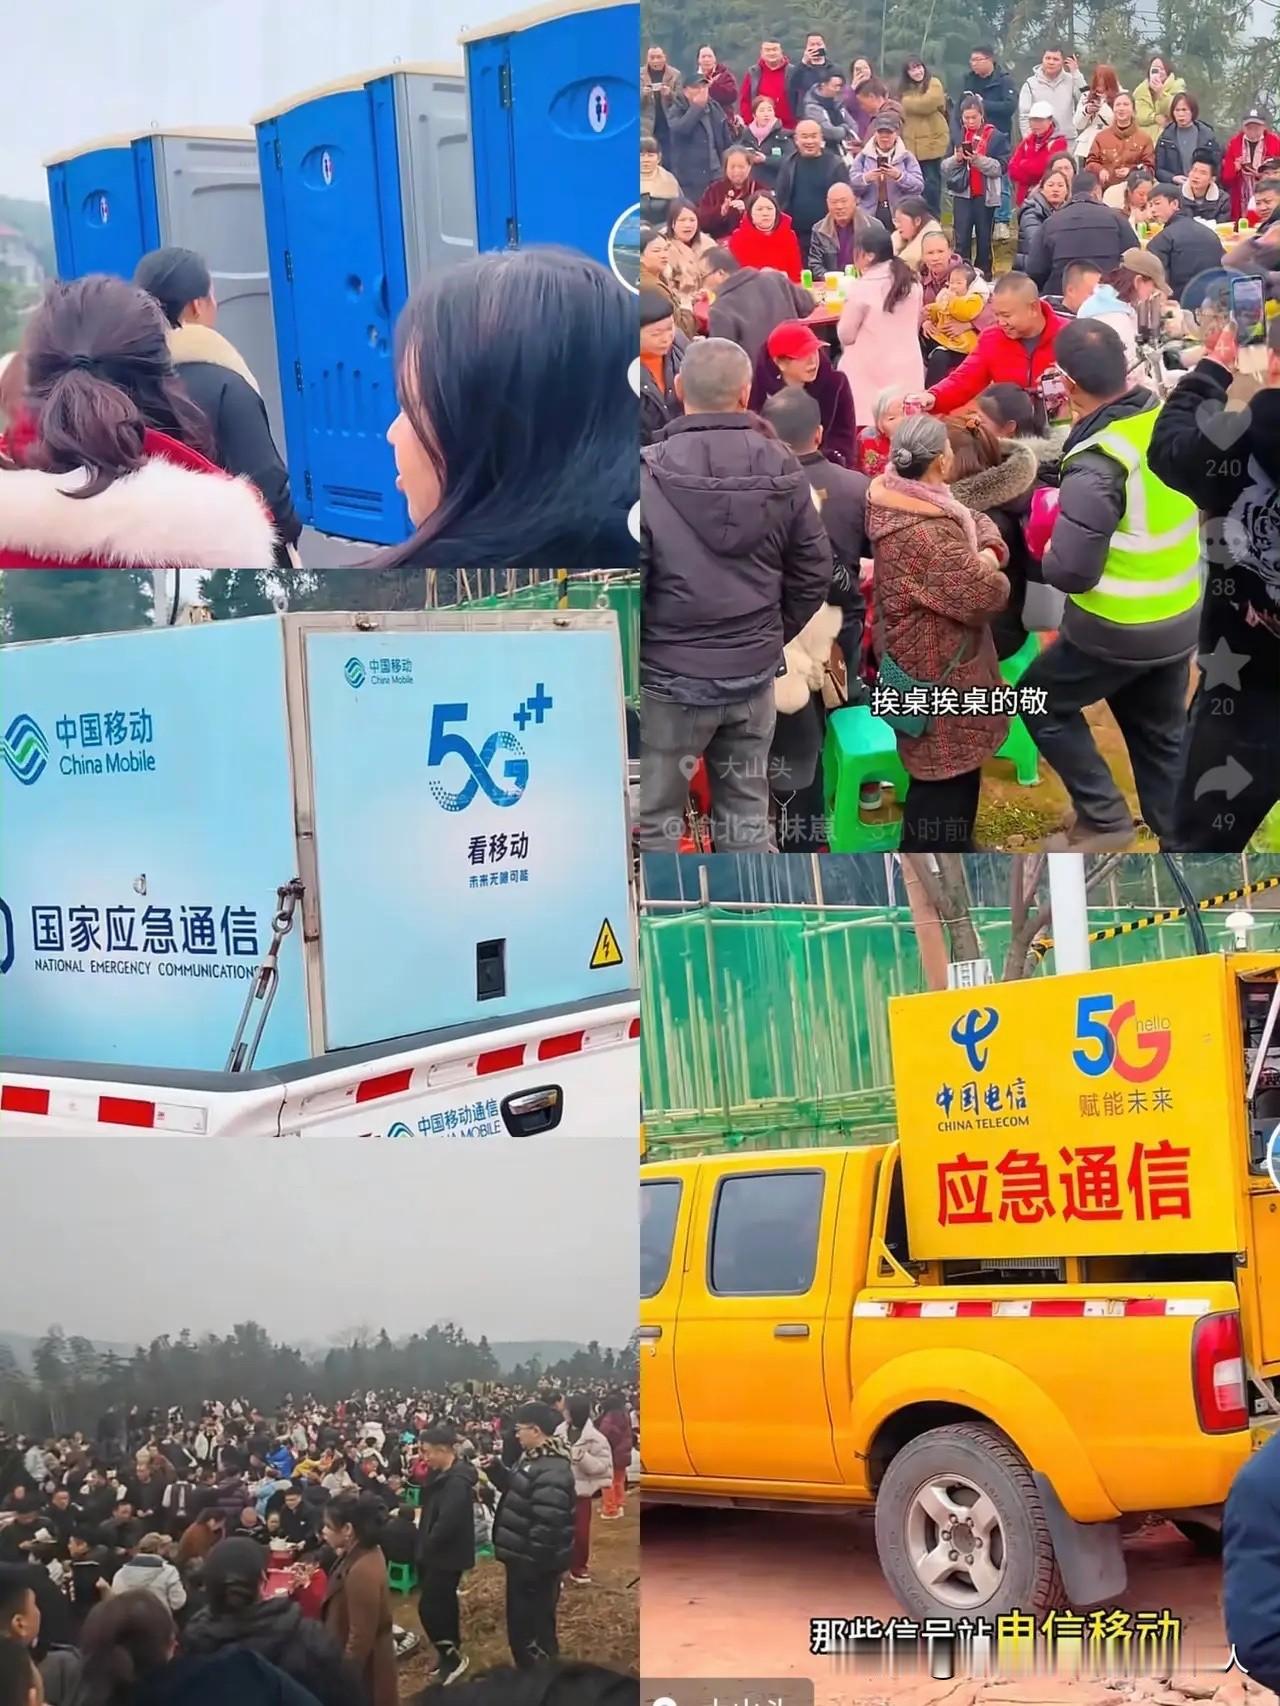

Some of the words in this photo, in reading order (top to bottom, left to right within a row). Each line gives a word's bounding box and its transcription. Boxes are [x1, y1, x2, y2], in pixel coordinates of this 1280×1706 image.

[369, 658, 413, 674] 中国移动
[55, 707, 153, 750] 中国移动
[59, 754, 103, 777] China
[105, 751, 156, 774] Mobile
[467, 830, 529, 866] 看移动
[31, 904, 259, 957] 国家应急通信
[34, 958, 86, 974] NATIONAL
[90, 960, 151, 976] EMERGENCY
[1071, 993, 1172, 1084] 5G
[1135, 1015, 1171, 1033] hello
[935, 1076, 1027, 1120] 中国电信
[1079, 1086, 1174, 1118] 赋能未来
[417, 1098, 499, 1137] 中国移动通信
[937, 1119, 974, 1132] CHINA
[975, 1115, 1030, 1129] TELECOM
[936, 1138, 1192, 1228] 应急通信
